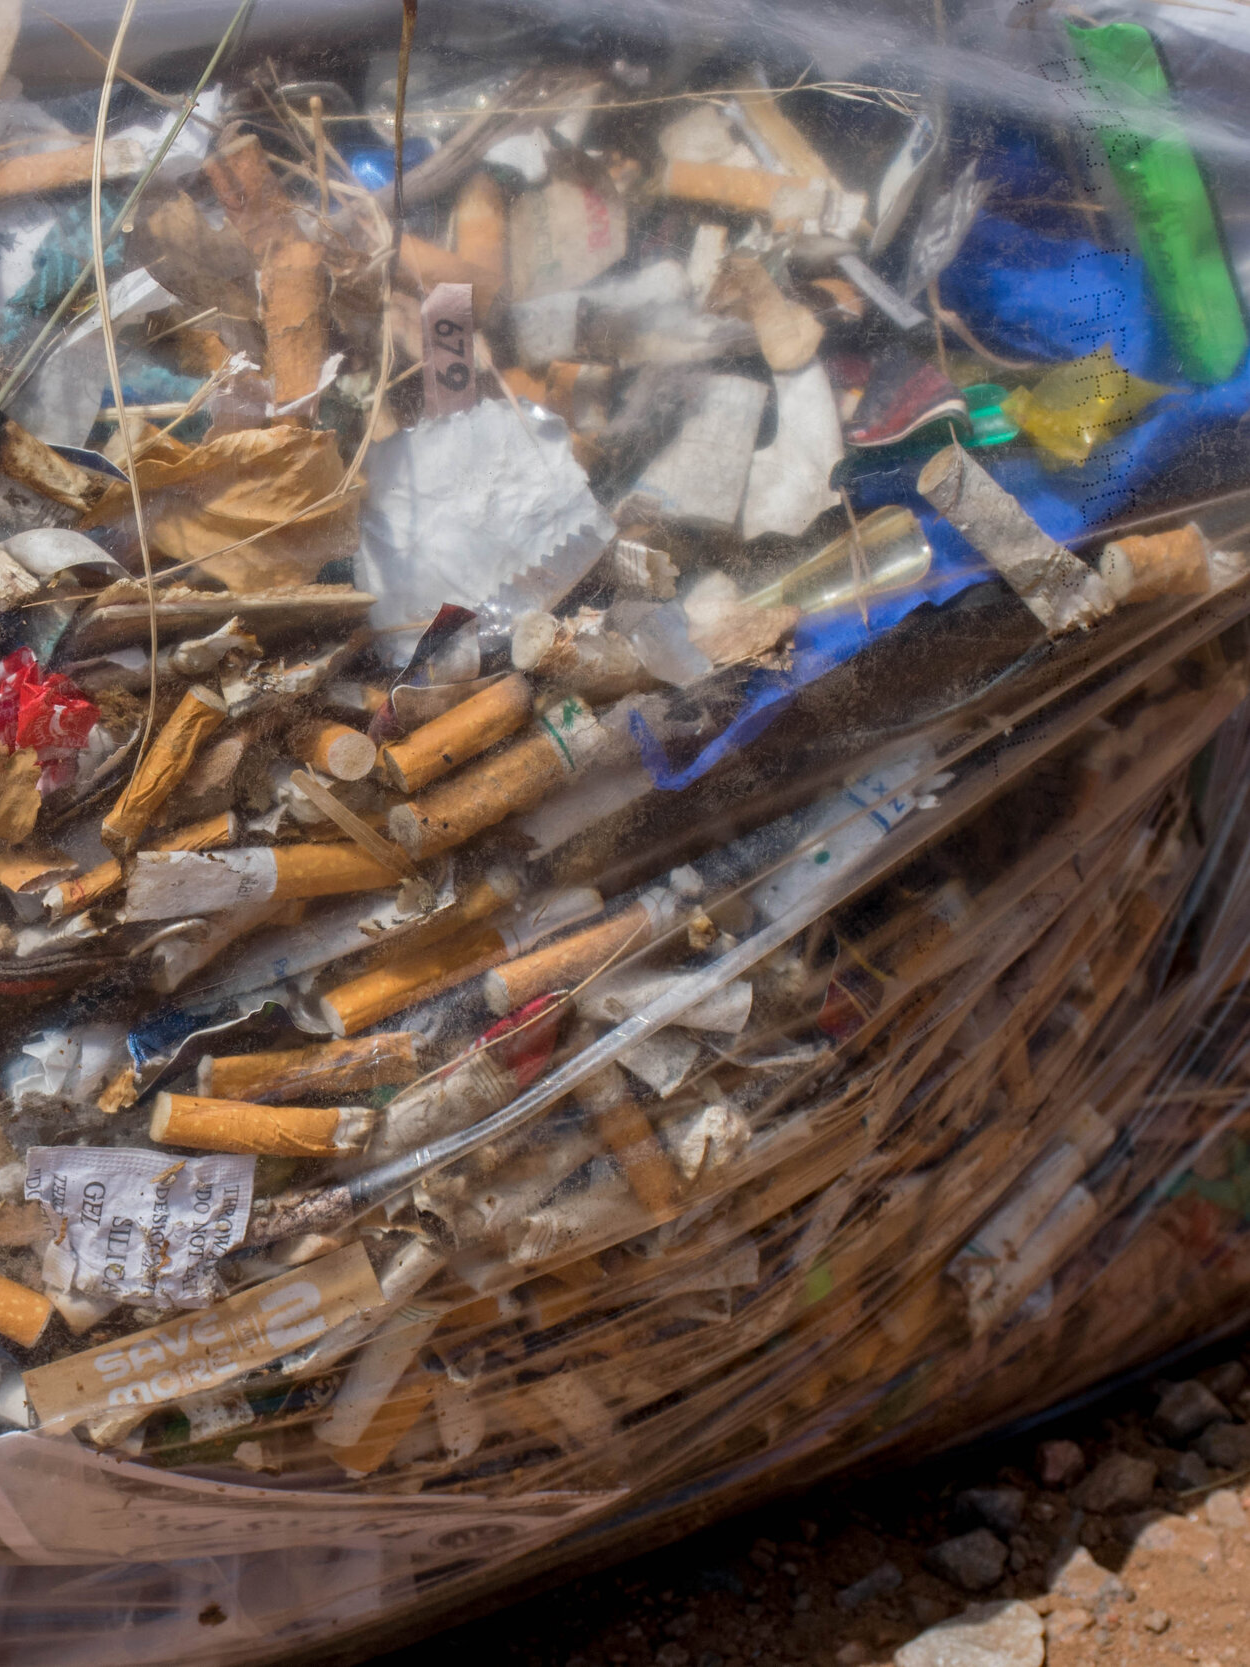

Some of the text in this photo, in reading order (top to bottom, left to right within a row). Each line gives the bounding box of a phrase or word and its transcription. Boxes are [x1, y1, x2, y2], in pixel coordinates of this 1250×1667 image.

[435, 319, 469, 391] 679
[1062, 248, 1135, 588] CARRIAGS
[80, 1181, 106, 1227] GEL
[101, 1216, 132, 1296] SILICA
[188, 1222, 206, 1259] NOT
[93, 1313, 226, 1384] SAVE
[107, 1346, 238, 1408] MORE
